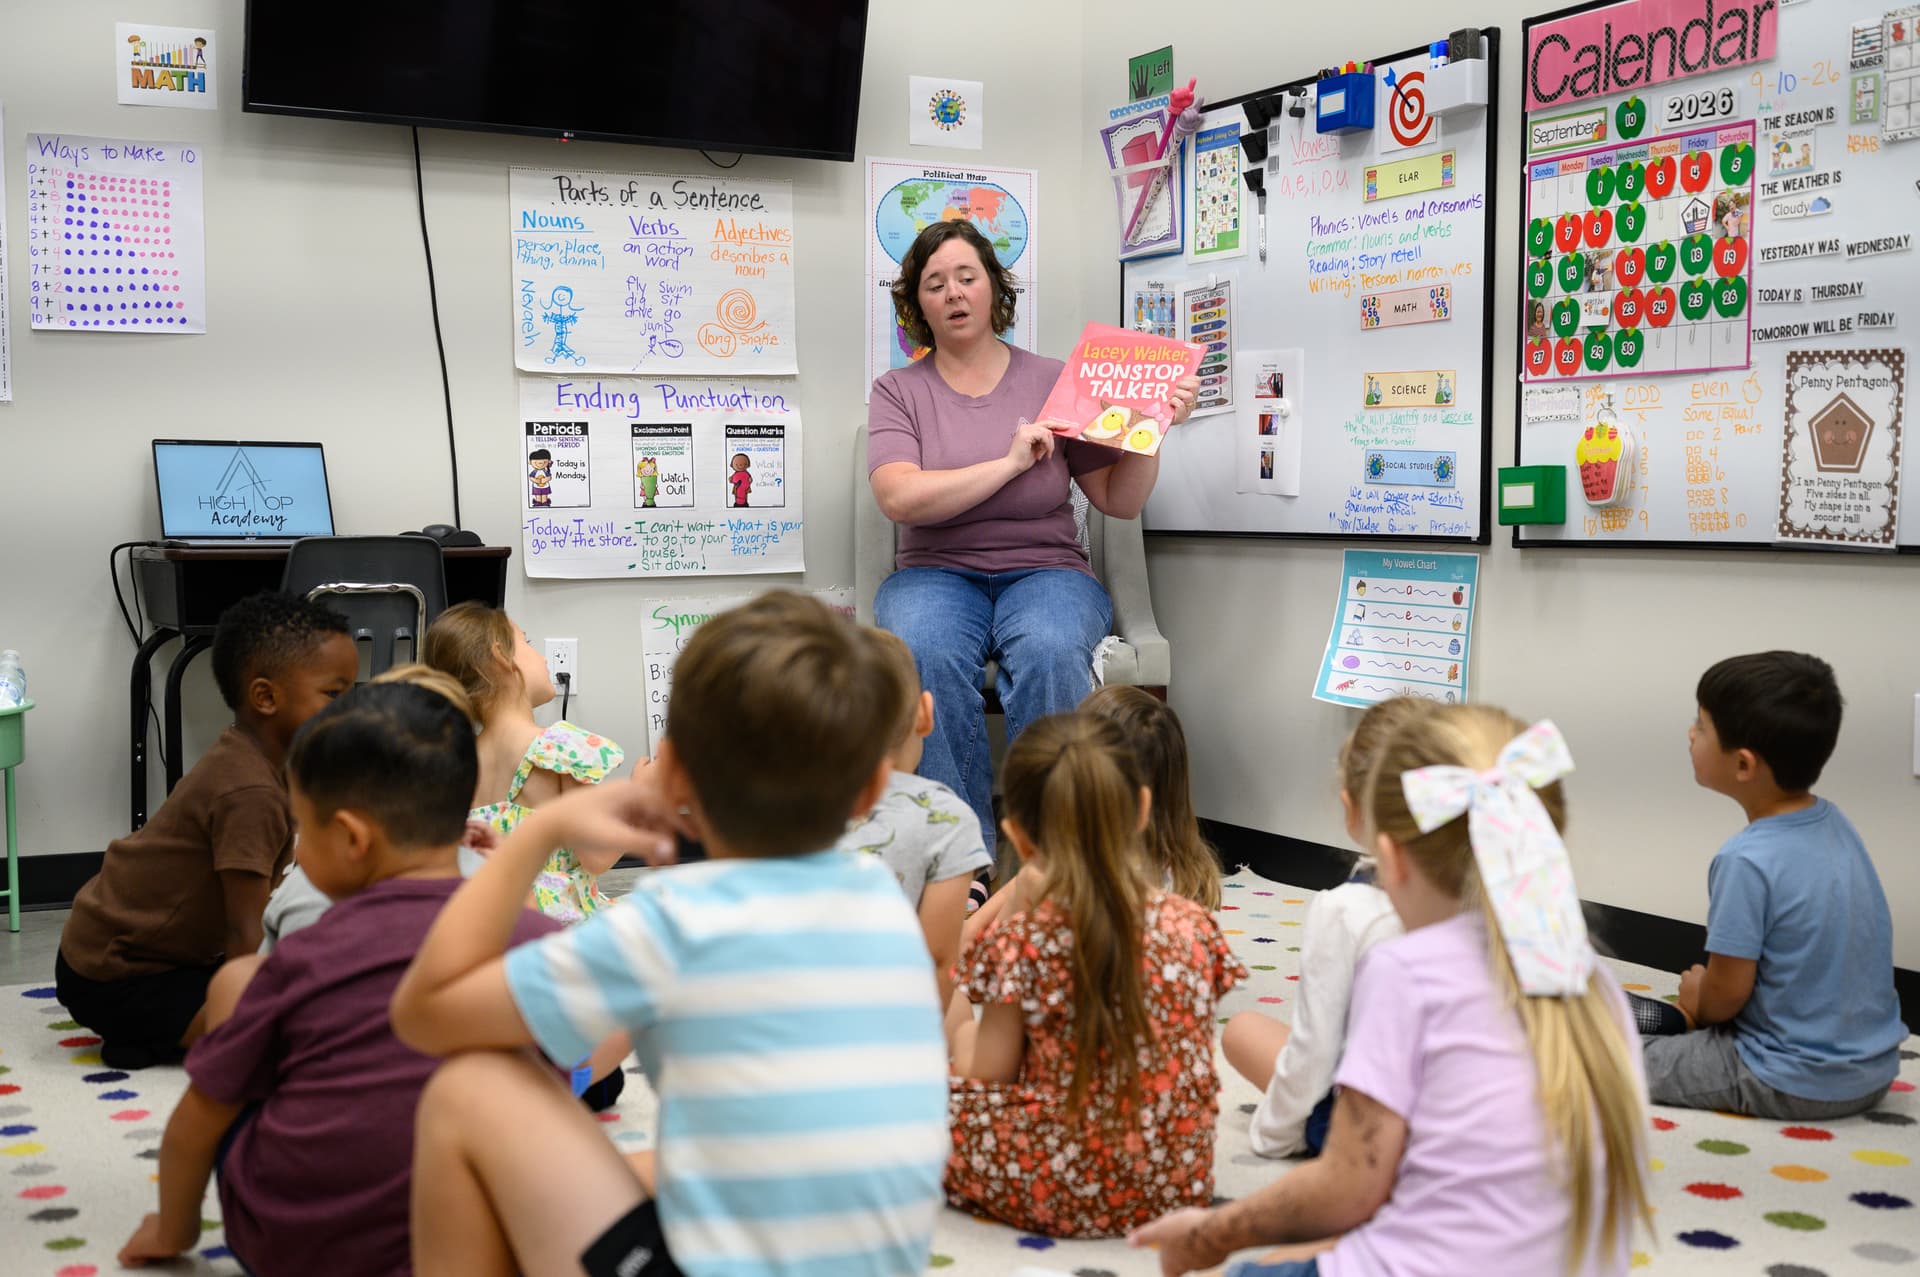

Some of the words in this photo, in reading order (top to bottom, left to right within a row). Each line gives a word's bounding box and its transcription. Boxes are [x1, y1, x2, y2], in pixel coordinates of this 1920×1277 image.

[1530, 0, 1776, 103] Calendar
[1153, 59, 1170, 77] Left
[1849, 53, 1884, 70] NUMBER
[131, 67, 206, 93] MATH
[1667, 88, 1734, 123] 2026
[1625, 114, 1635, 126] 10
[1764, 118, 1781, 131] THE
[1784, 109, 1824, 127] SEASON
[1826, 107, 1835, 119] IS
[1533, 119, 1598, 146] September
[1782, 128, 1814, 140] Summer
[37, 136, 90, 167] Ways
[100, 145, 118, 160] to
[123, 145, 166, 162] Make
[181, 150, 196, 163] 10
[1534, 166, 1554, 177] Sunday
[1561, 161, 1584, 172] Monday
[1590, 154, 1613, 167] Tuesday
[1617, 148, 1650, 161] Wednesday
[1650, 142, 1679, 154] Thursday
[1687, 136, 1708, 150] Friday
[1718, 131, 1750, 144] Saturday
[923, 170, 963, 180] Political
[966, 172, 987, 182] Map
[1399, 171, 1420, 184] ELAR
[1626, 175, 1634, 189] 2
[1656, 171, 1665, 185] 3
[1690, 167, 1700, 180] 4
[1732, 158, 1741, 172] 5
[1761, 183, 1779, 196] THE
[1782, 173, 1830, 193] WEATHER
[1833, 171, 1842, 183] IS
[552, 176, 609, 202] Parts
[620, 182, 639, 203] of
[650, 195, 664, 206] a
[672, 181, 764, 210] Sentence
[1773, 201, 1810, 217] Cloudy
[522, 210, 585, 230] Nouns
[629, 216, 680, 236] Verbs
[1310, 215, 1354, 237] Phonics:
[1405, 201, 1425, 219] and
[715, 218, 792, 246] Adjectives
[1399, 224, 1421, 244] and
[1536, 231, 1544, 244] 6
[1565, 227, 1573, 240] 7
[1593, 222, 1602, 235] 8
[1626, 216, 1634, 229] 9
[623, 243, 641, 254] an
[647, 240, 693, 256] action
[710, 244, 775, 263] describes
[780, 253, 789, 265] a
[1761, 242, 1815, 261] YESTERDAY
[1818, 240, 1840, 254] WAS
[1846, 235, 1911, 257] WEDNESDAY
[735, 265, 765, 279] noun
[1309, 256, 1355, 278] Reading:
[1358, 250, 1387, 269] Story
[1534, 273, 1545, 286] 13
[1567, 267, 1577, 280] 14
[1624, 261, 1636, 274] 16
[1654, 257, 1666, 270] 17
[1691, 248, 1703, 262] 18
[1723, 250, 1736, 263] 19
[626, 276, 646, 298] fly
[1147, 281, 1165, 292] Feelings
[1309, 277, 1356, 298] Writing:
[1758, 289, 1791, 302] TODAY
[1794, 289, 1802, 301] IS
[1811, 282, 1864, 300] THURSDAY
[664, 309, 681, 322] go
[1394, 302, 1417, 313] MATH
[1561, 311, 1571, 325] 21
[1623, 302, 1636, 315] 23
[1653, 300, 1668, 314] 24
[1689, 295, 1703, 308] 25
[1721, 290, 1738, 304] 26
[640, 321, 673, 338] jump
[1751, 324, 1809, 341] TOMORROW
[1813, 321, 1835, 335] WILL
[1839, 318, 1853, 331] BE
[1858, 313, 1895, 326] FRIDAY
[704, 329, 731, 353] long
[1083, 342, 1130, 363] Lacey
[1135, 346, 1191, 363] Walker,
[1533, 351, 1545, 364] 27
[1562, 350, 1575, 363] 28
[1591, 346, 1604, 360] 29
[1622, 342, 1635, 355] 30
[1080, 362, 1185, 381] NONSTOP
[1090, 380, 1169, 401] TALKER
[1391, 384, 1427, 395] SCIENCE
[1691, 381, 1729, 400] Even
[1800, 376, 1833, 391] Penny
[1836, 375, 1889, 390] Pentagon
[556, 382, 640, 418] Ending
[654, 384, 790, 412] Punctuation
[533, 423, 582, 435] Periods
[727, 427, 759, 436] Question
[760, 427, 784, 435] Marks
[556, 460, 578, 469] Today
[1385, 462, 1407, 470] SOCIAL
[661, 473, 690, 483] Watch
[1804, 479, 1815, 487] am
[1817, 477, 1842, 489] Penny
[1843, 479, 1882, 490] Pentagon
[666, 485, 686, 495] Out!
[1806, 488, 1824, 499] Five
[1826, 489, 1847, 499] sides
[1849, 491, 1856, 500] in
[198, 495, 246, 510] HIGH
[1805, 501, 1817, 512] My
[1818, 502, 1842, 512] shape
[211, 510, 287, 531] Academy
[573, 518, 584, 535] I
[588, 521, 613, 534] will
[651, 520, 683, 534] can't
[687, 520, 715, 532] wait
[1843, 513, 1861, 524] ball!
[767, 520, 777, 531] is
[781, 522, 803, 536] your
[532, 539, 547, 554] go
[551, 536, 566, 548] to
[572, 536, 596, 548] the
[600, 535, 637, 547] store.
[643, 535, 658, 545] to
[663, 536, 677, 549] go
[681, 534, 696, 544] to
[701, 534, 727, 551] your
[731, 532, 780, 544] favorite
[731, 544, 767, 556] fruit?
[642, 559, 661, 571] Sit
[1382, 558, 1393, 570] My
[1395, 558, 1416, 568] Vowel
[1417, 560, 1437, 570] Chart
[1405, 611, 1412, 620] e
